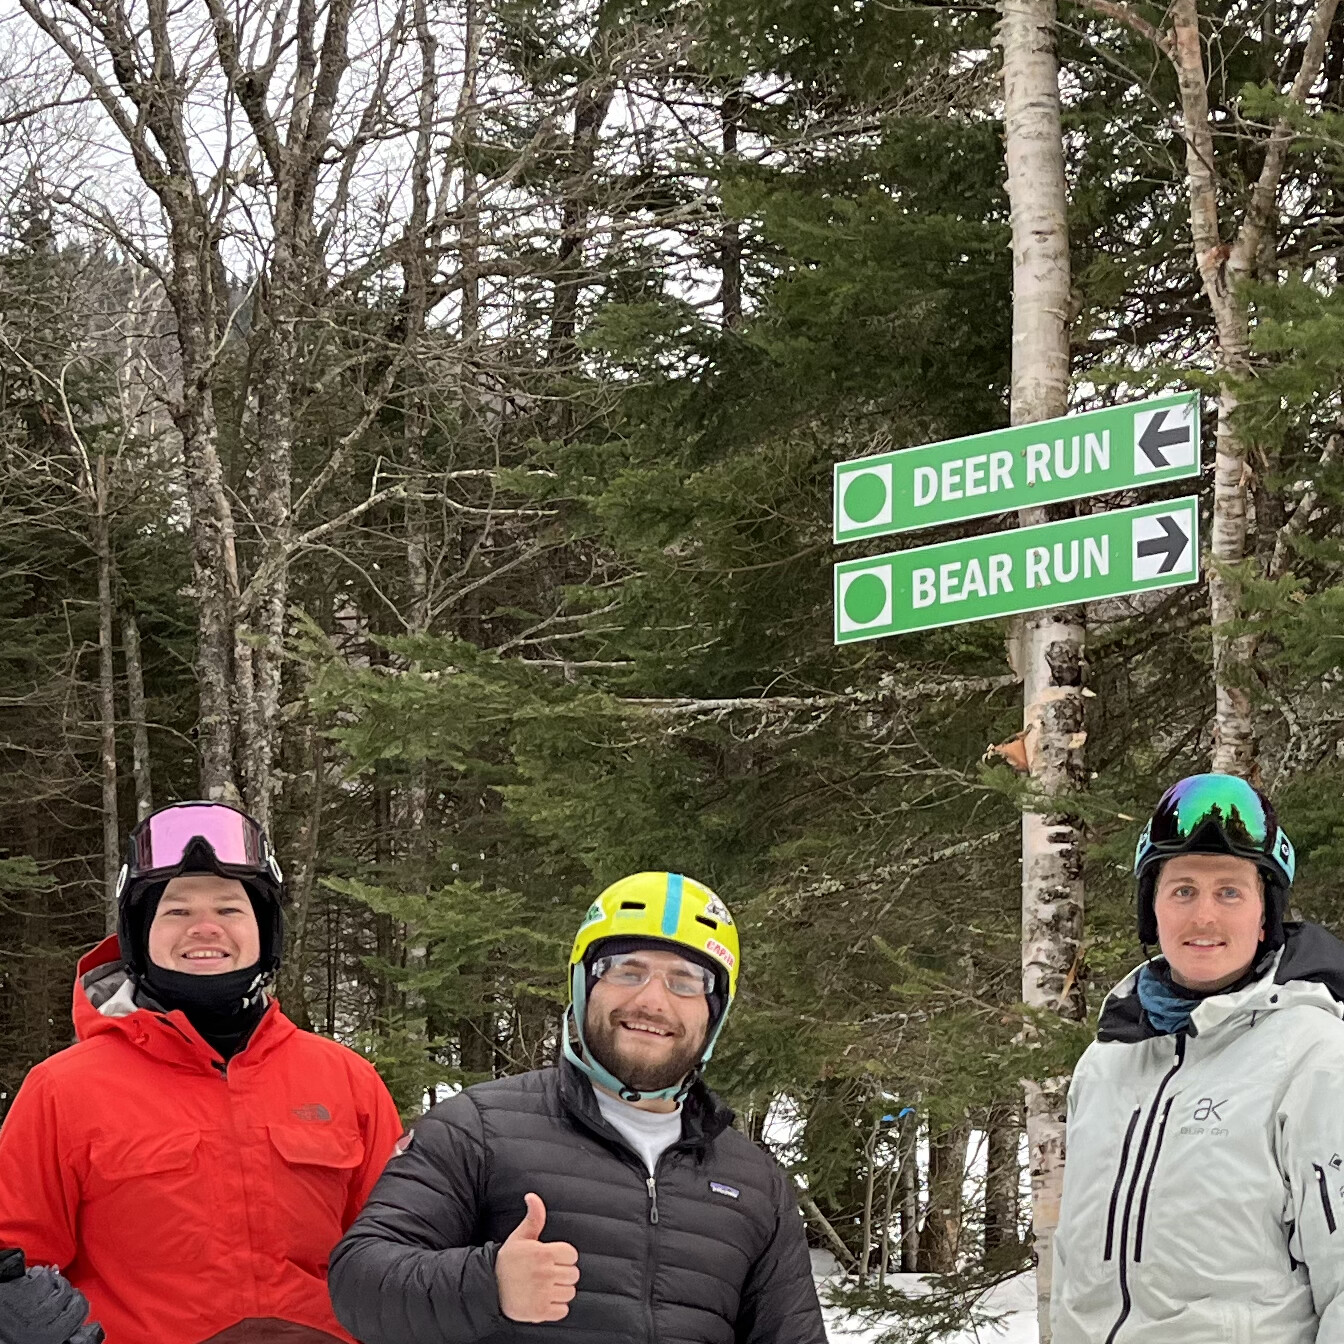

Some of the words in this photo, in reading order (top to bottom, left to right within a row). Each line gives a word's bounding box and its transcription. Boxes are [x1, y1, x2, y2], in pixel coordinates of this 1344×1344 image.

[913, 449, 1015, 507] DEER
[1025, 429, 1111, 483] RUN
[912, 553, 1014, 609] BEAR
[1025, 534, 1110, 589] RUN
[1180, 1126, 1229, 1136] BURON
